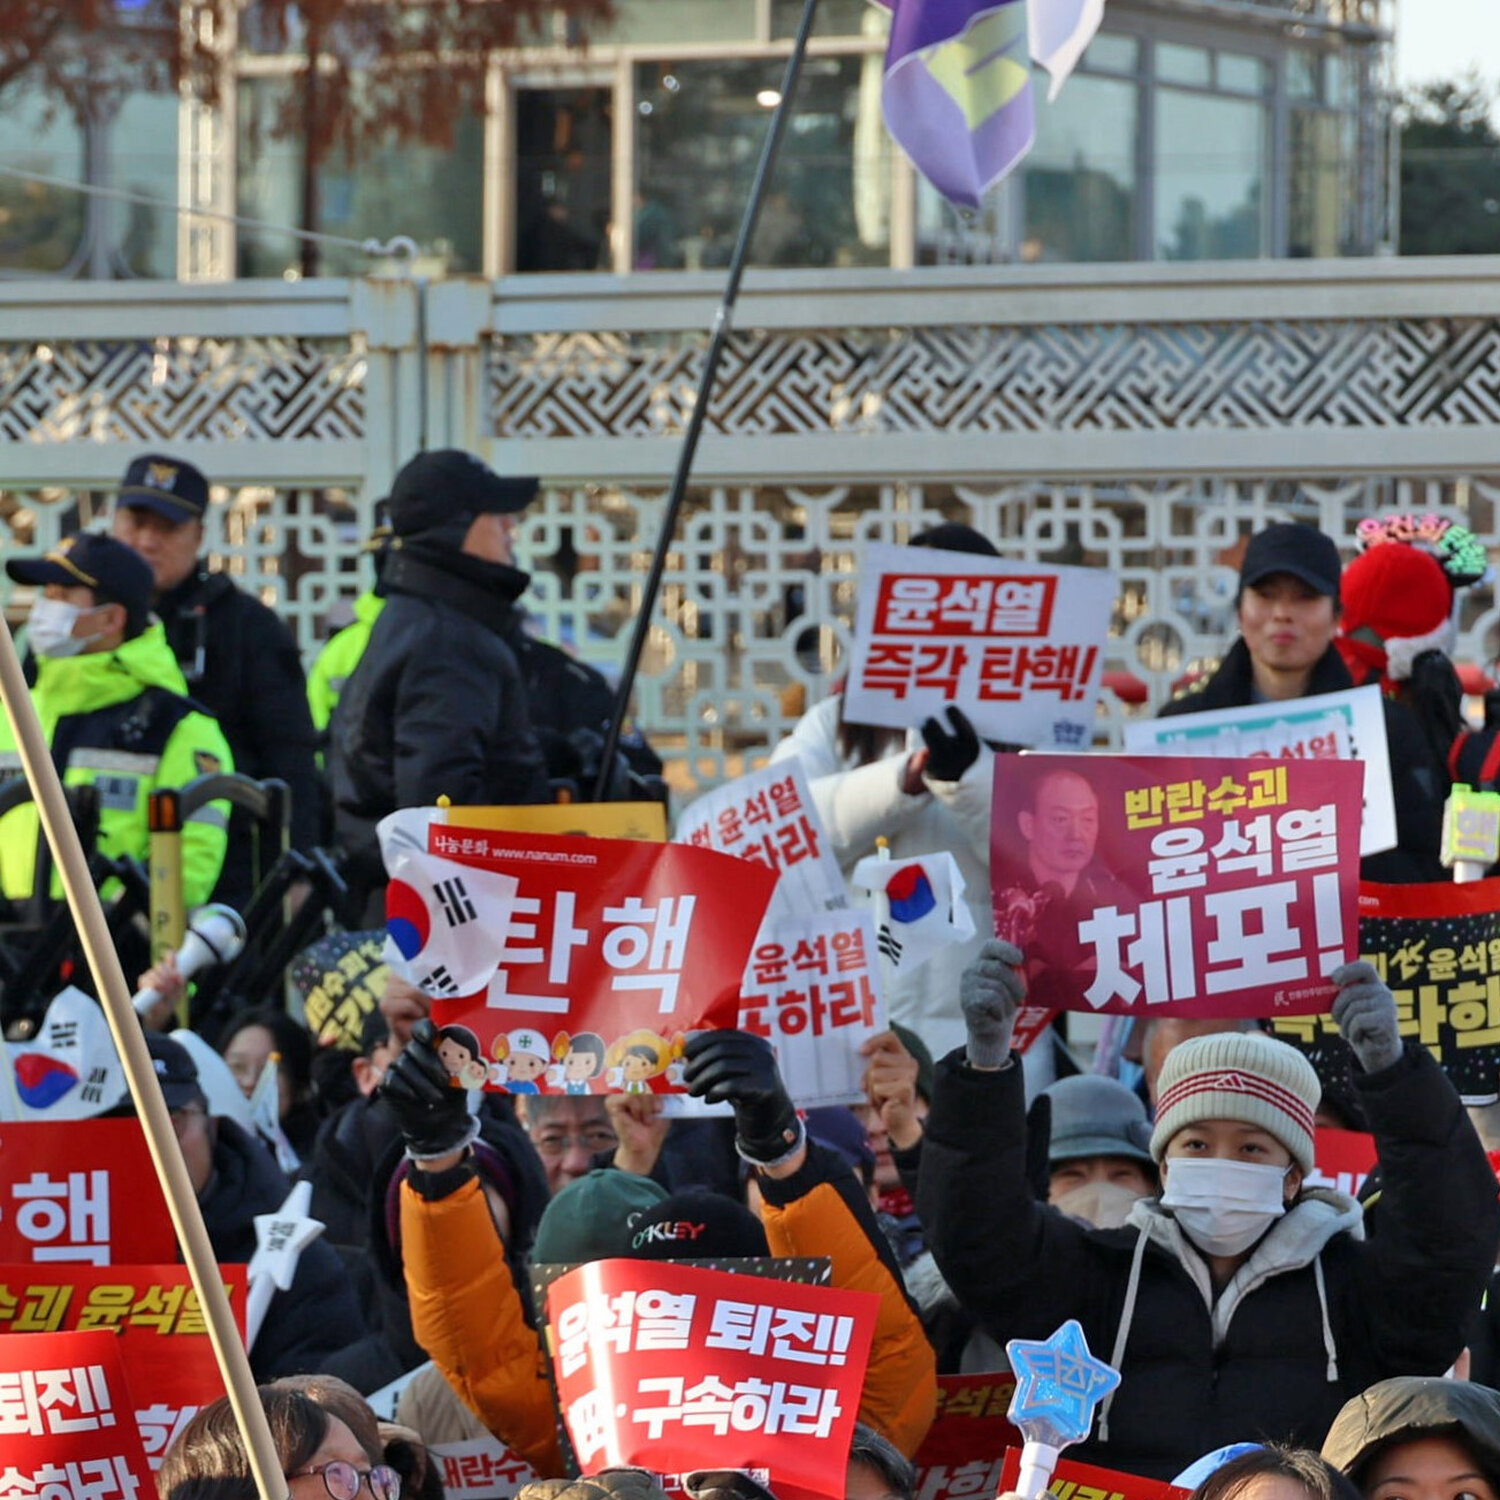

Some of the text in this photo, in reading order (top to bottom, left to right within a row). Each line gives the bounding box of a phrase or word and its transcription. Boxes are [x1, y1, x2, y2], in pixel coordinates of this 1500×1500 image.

[885, 578, 1047, 633] 윤석열
[862, 643, 1099, 701] 즉각 탄핵!
[717, 775, 803, 846] 윤석열
[1125, 767, 1288, 830] 반란수괴
[434, 835, 597, 865] 나눔문화 www.nanum.com
[1148, 804, 1339, 894] 윤석열
[487, 891, 697, 1014] 탄핵
[753, 928, 867, 984] 윤석열
[1078, 872, 1346, 1009] 체포!
[740, 976, 876, 1037] 포하라
[12, 1171, 111, 1266] 핵
[633, 1220, 706, 1250] OAKLEY
[558, 1289, 854, 1378] 윤석열 퇴진!
[0, 1365, 117, 1436] 퇴진!
[444, 1449, 541, 1489] 내란수
